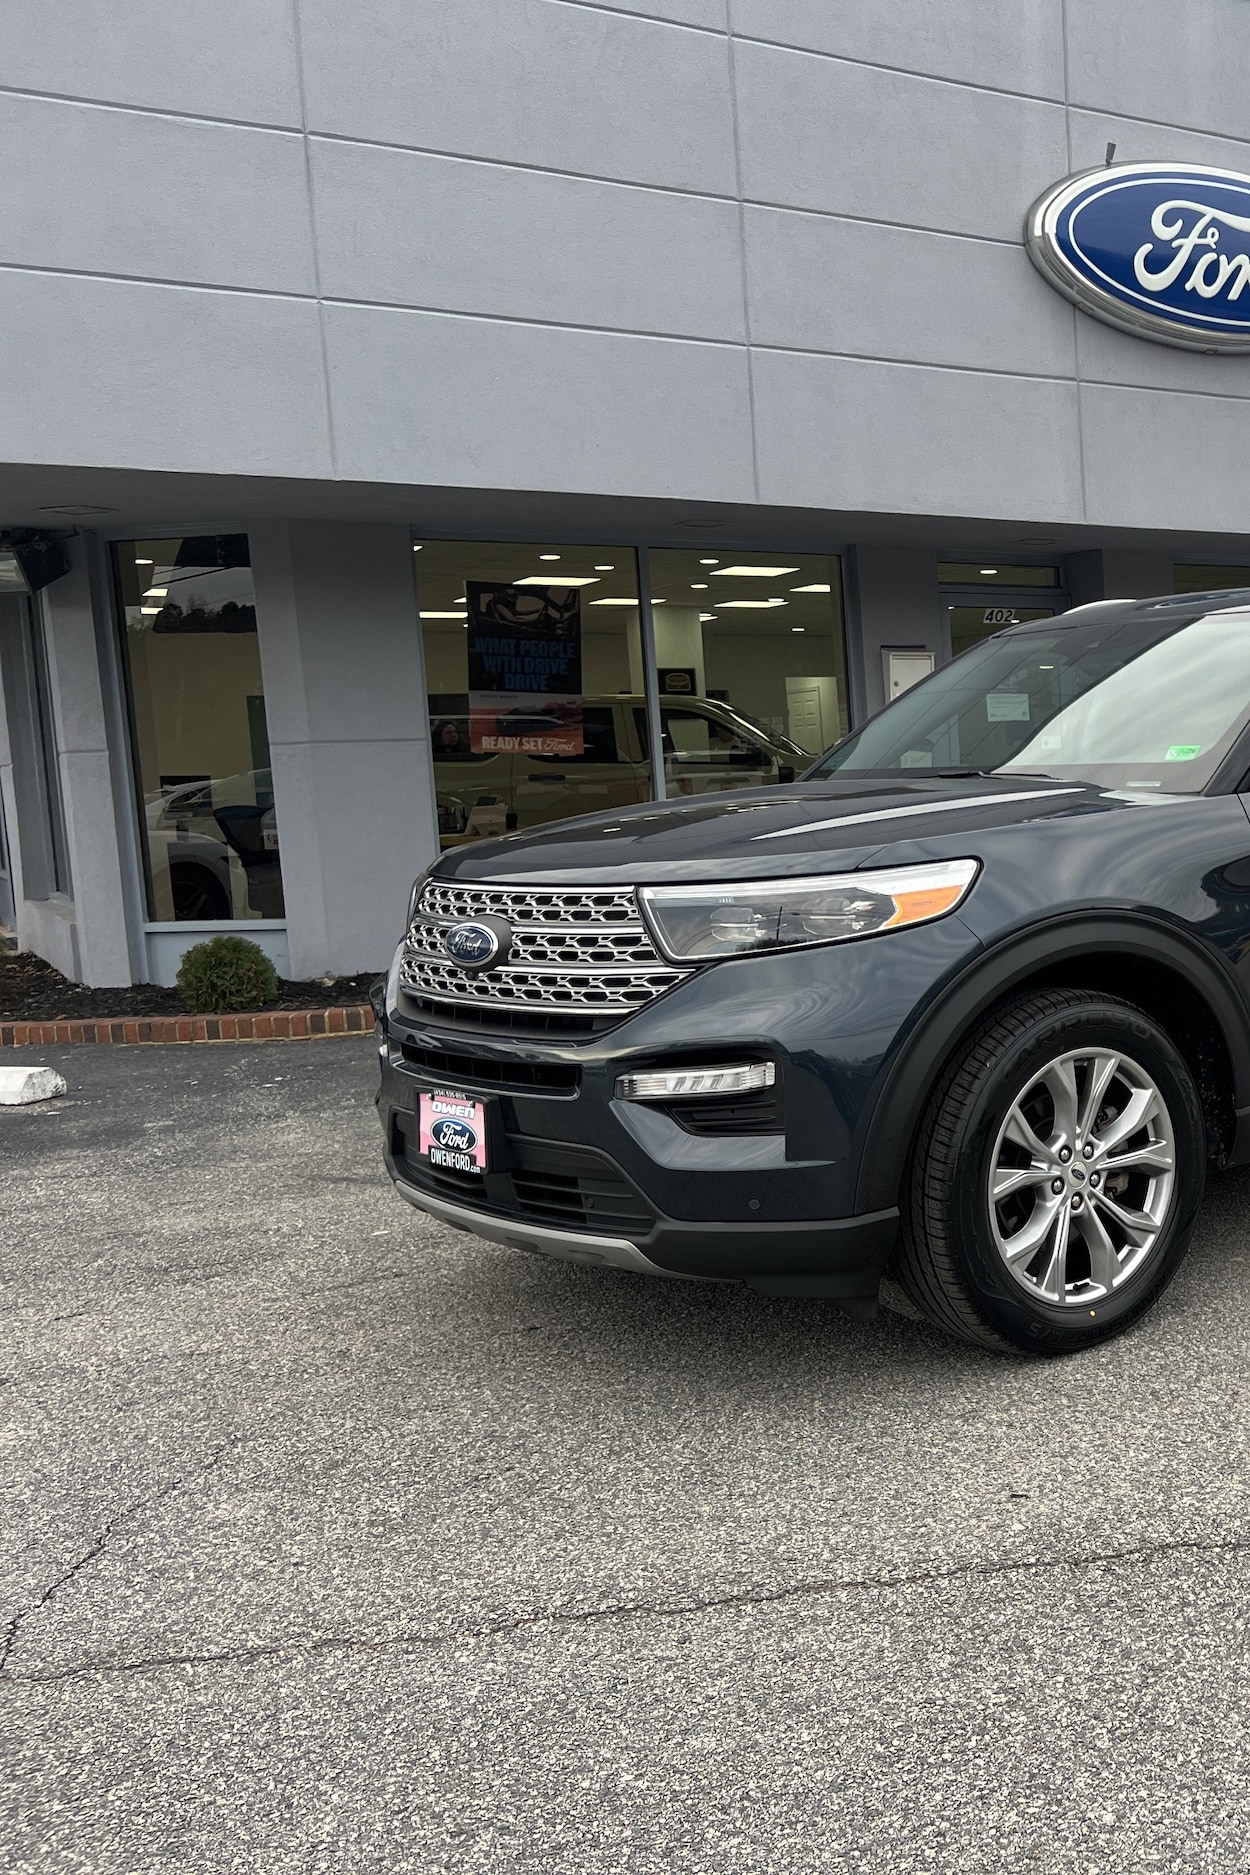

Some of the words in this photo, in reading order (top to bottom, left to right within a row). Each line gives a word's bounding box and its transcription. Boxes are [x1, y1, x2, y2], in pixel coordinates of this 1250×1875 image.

[985, 609, 1013, 623] 402
[475, 637, 516, 655] WHAT
[520, 640, 576, 659] PEOPLE
[483, 655, 523, 674] WITH
[524, 657, 569, 675] DRIVE
[504, 673, 549, 691] DRIVE
[481, 736, 519, 750] READY
[522, 737, 543, 751] SET
[543, 738, 575, 751] Ford
[451, 931, 483, 956] Ford
[440, 1121, 469, 1149] Ford
[430, 1148, 481, 1174] OWENFORD.com
